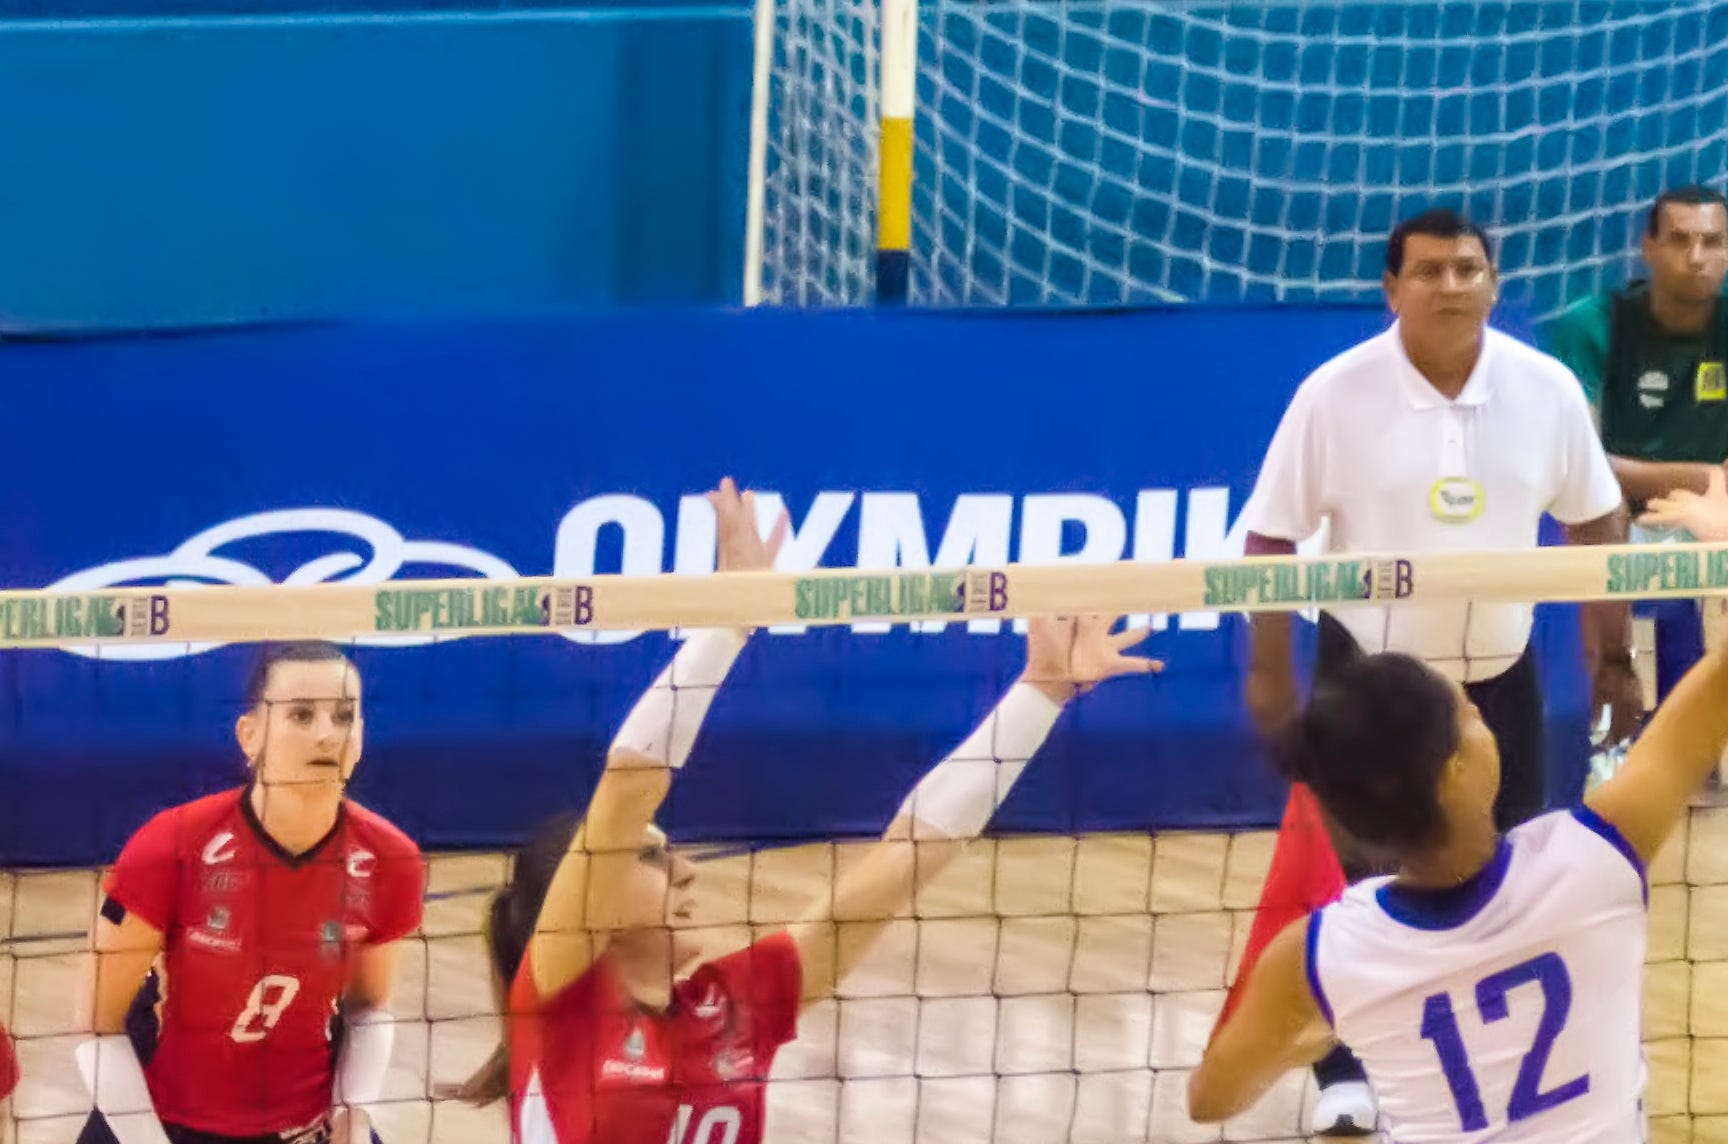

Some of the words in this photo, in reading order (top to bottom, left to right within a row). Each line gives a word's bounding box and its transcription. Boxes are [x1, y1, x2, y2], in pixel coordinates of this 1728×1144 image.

[553, 487, 1331, 644] OLYMPIK
[1205, 560, 1372, 605] SUPERLIGA
[1396, 560, 1413, 599] B
[0, 597, 124, 638] ERLIGA
[151, 595, 170, 635] B
[376, 586, 550, 631] SUPERLIGA
[574, 586, 593, 625] B
[796, 574, 965, 619] SUPERLIGA
[989, 572, 1008, 611] B
[229, 974, 300, 1044] 8
[1420, 951, 1590, 1132] 12
